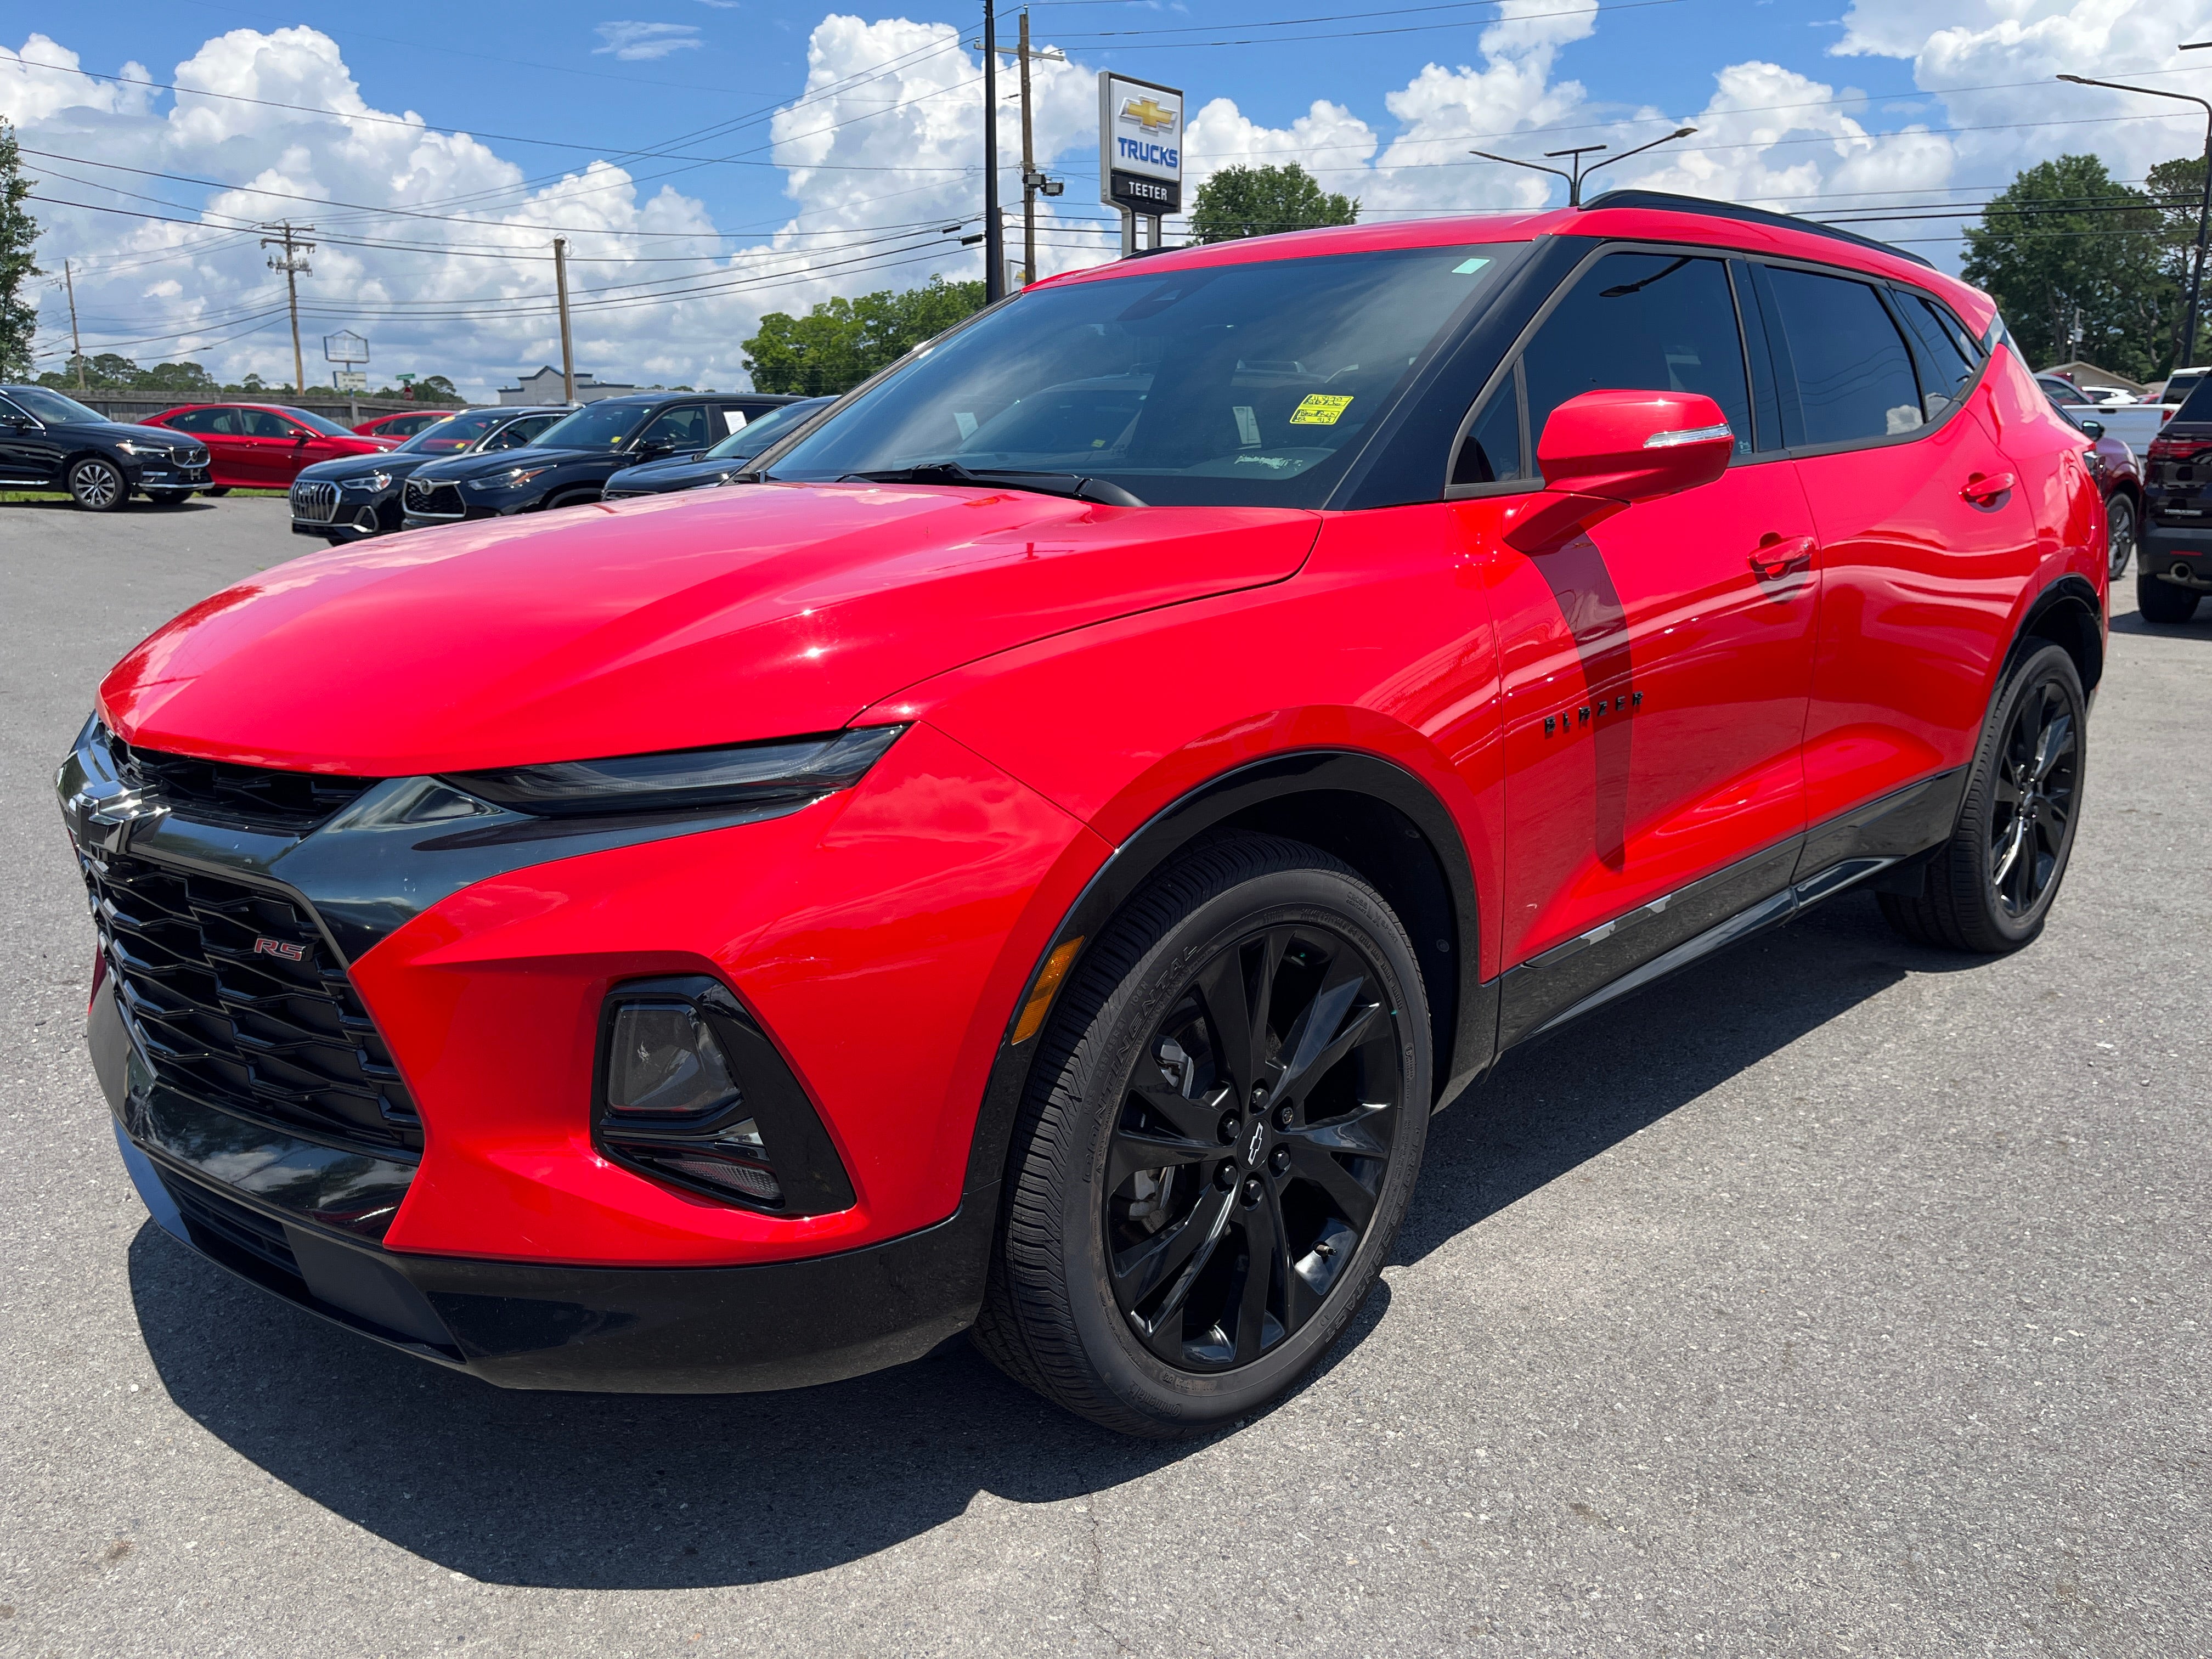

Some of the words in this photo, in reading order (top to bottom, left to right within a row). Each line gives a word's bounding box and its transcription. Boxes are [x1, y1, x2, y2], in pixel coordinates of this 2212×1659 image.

[1118, 137, 1177, 167] TRUCKS
[1128, 182, 1168, 201] TEETER
[1544, 691, 1644, 733] BLAZER
[254, 938, 307, 961] RS
[1082, 946, 1198, 1183] CONTINENTAL
